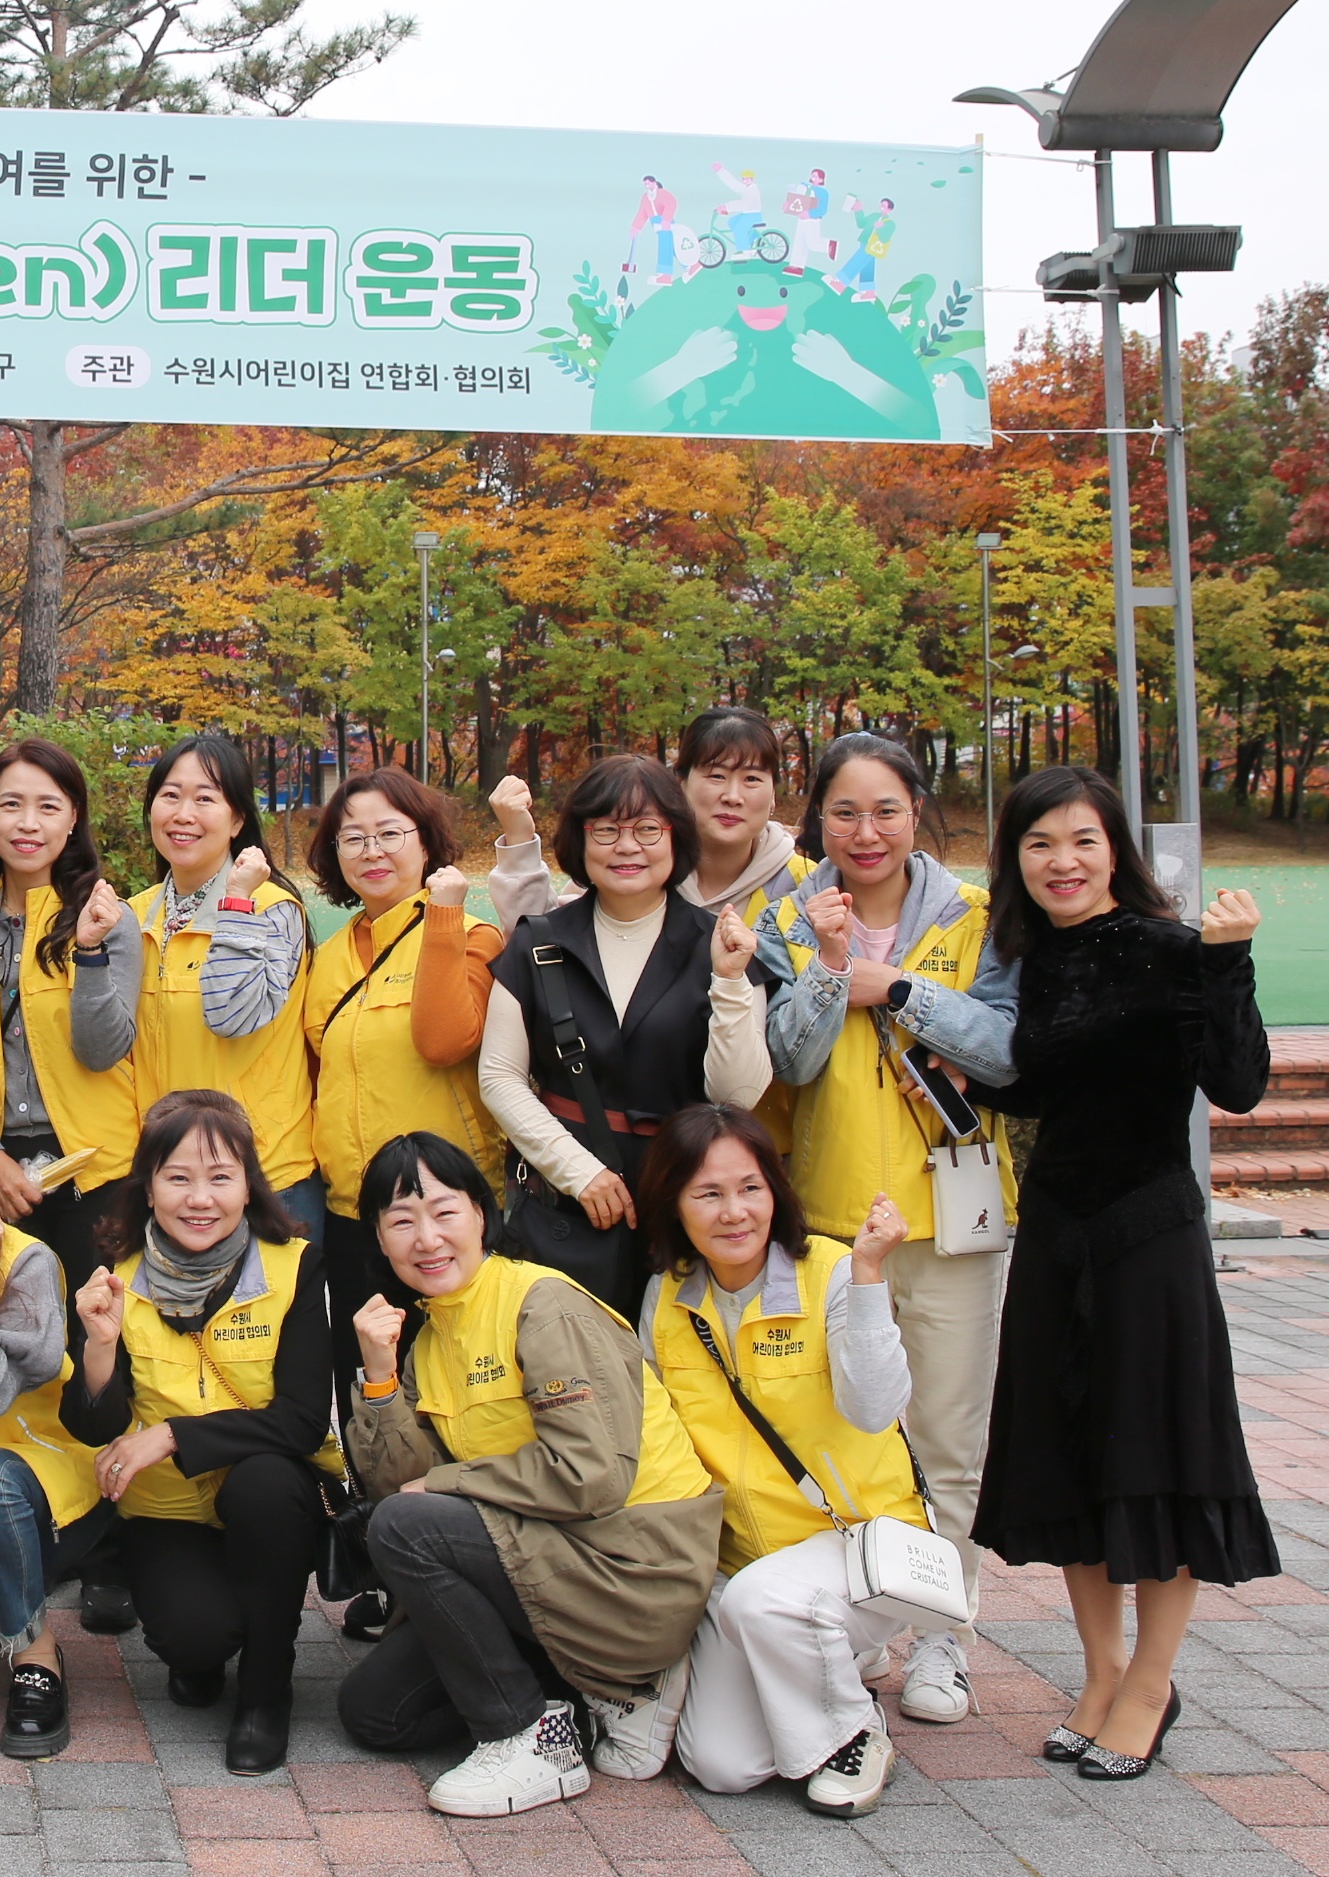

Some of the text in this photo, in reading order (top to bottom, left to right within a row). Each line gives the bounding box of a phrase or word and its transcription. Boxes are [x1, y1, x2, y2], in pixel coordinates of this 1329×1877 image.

[86, 152, 174, 200] 위한
[158, 232, 328, 317] 리더
[354, 238, 530, 322] 운동
[81, 355, 134, 384] 주관
[164, 357, 351, 390] 수원시어린이집
[360, 362, 531, 395] 연합회·협의회
[230, 1311, 251, 1325] 수원시
[213, 1324, 270, 1341] 어린이집 협의회
[767, 1328, 791, 1341] 수원시
[752, 1341, 783, 1357] 어린이집
[906, 1543, 946, 1567] BRILLA
[908, 1557, 948, 1579] COME UN
[910, 1570, 950, 1592] CRISTALLO
